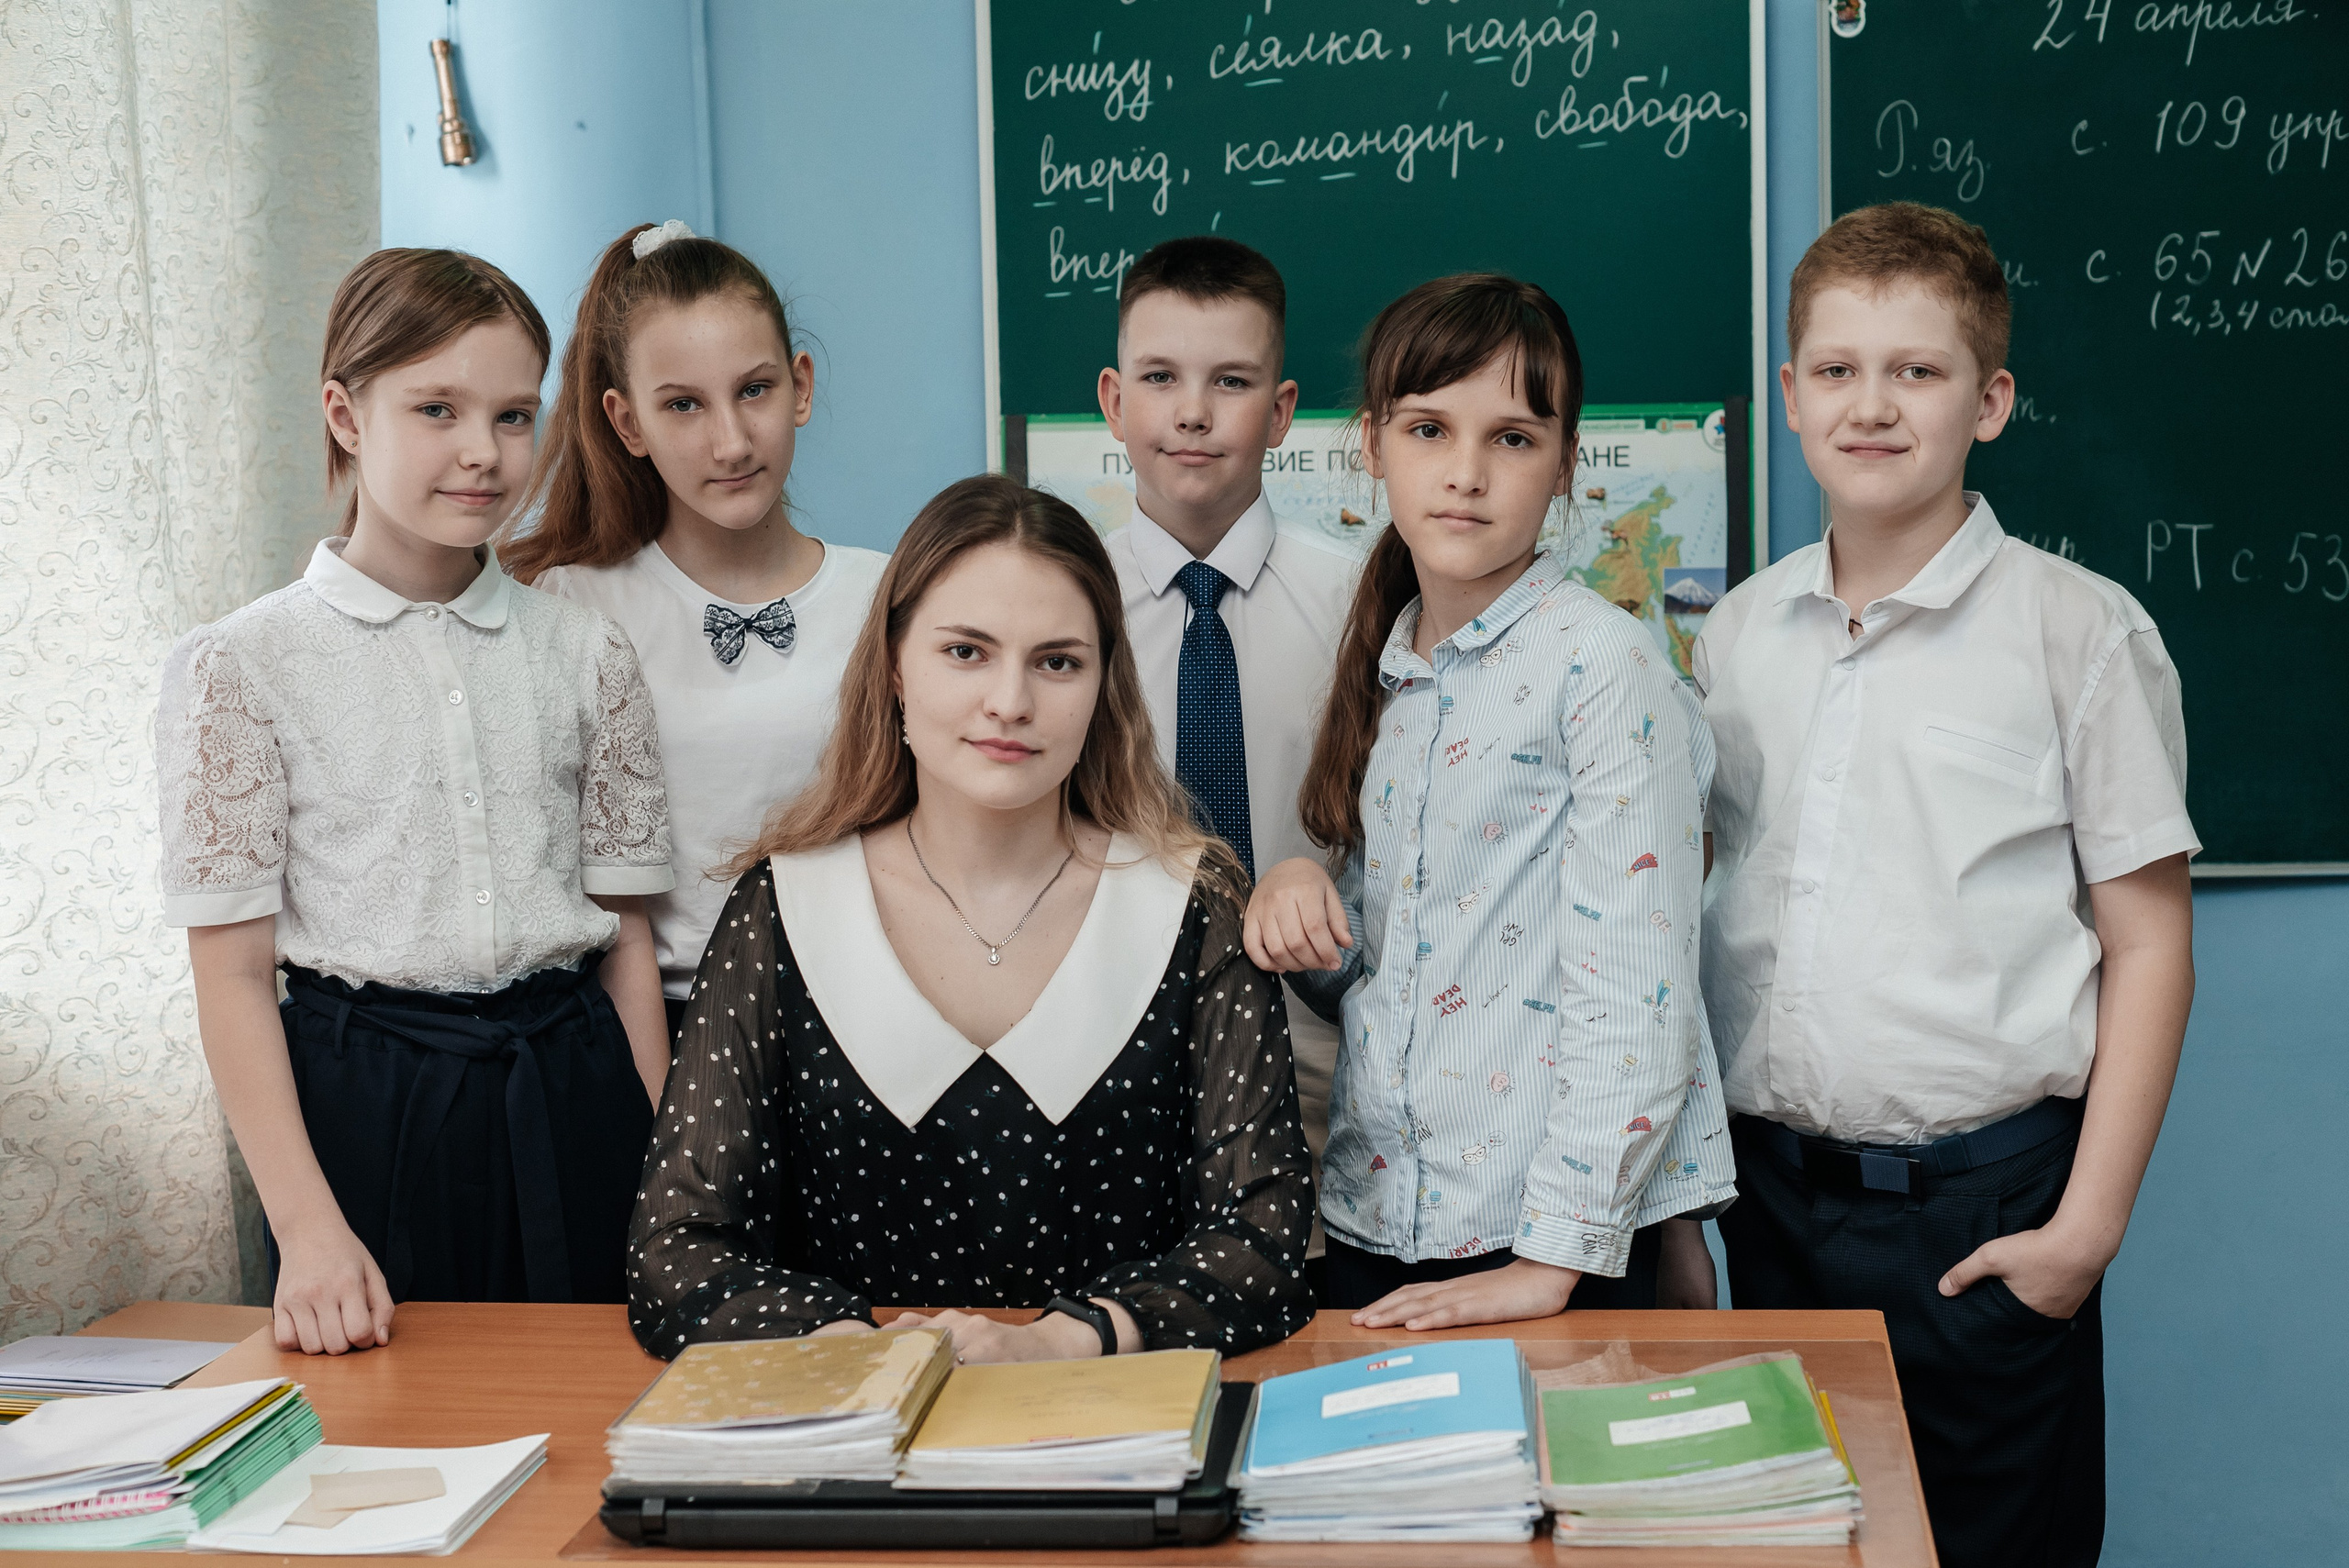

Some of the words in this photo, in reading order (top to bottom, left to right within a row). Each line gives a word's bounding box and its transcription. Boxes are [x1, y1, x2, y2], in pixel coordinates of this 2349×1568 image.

[2155, 95, 2247, 154] 109
[1049, 225, 1136, 301] впер
[2154, 231, 2221, 285] 65
[1576, 445, 1631, 468] АНЕ
[1447, 749, 1468, 768] HEY
[1440, 996, 1468, 1018] HEY
[1581, 1232, 1598, 1256] CAN
